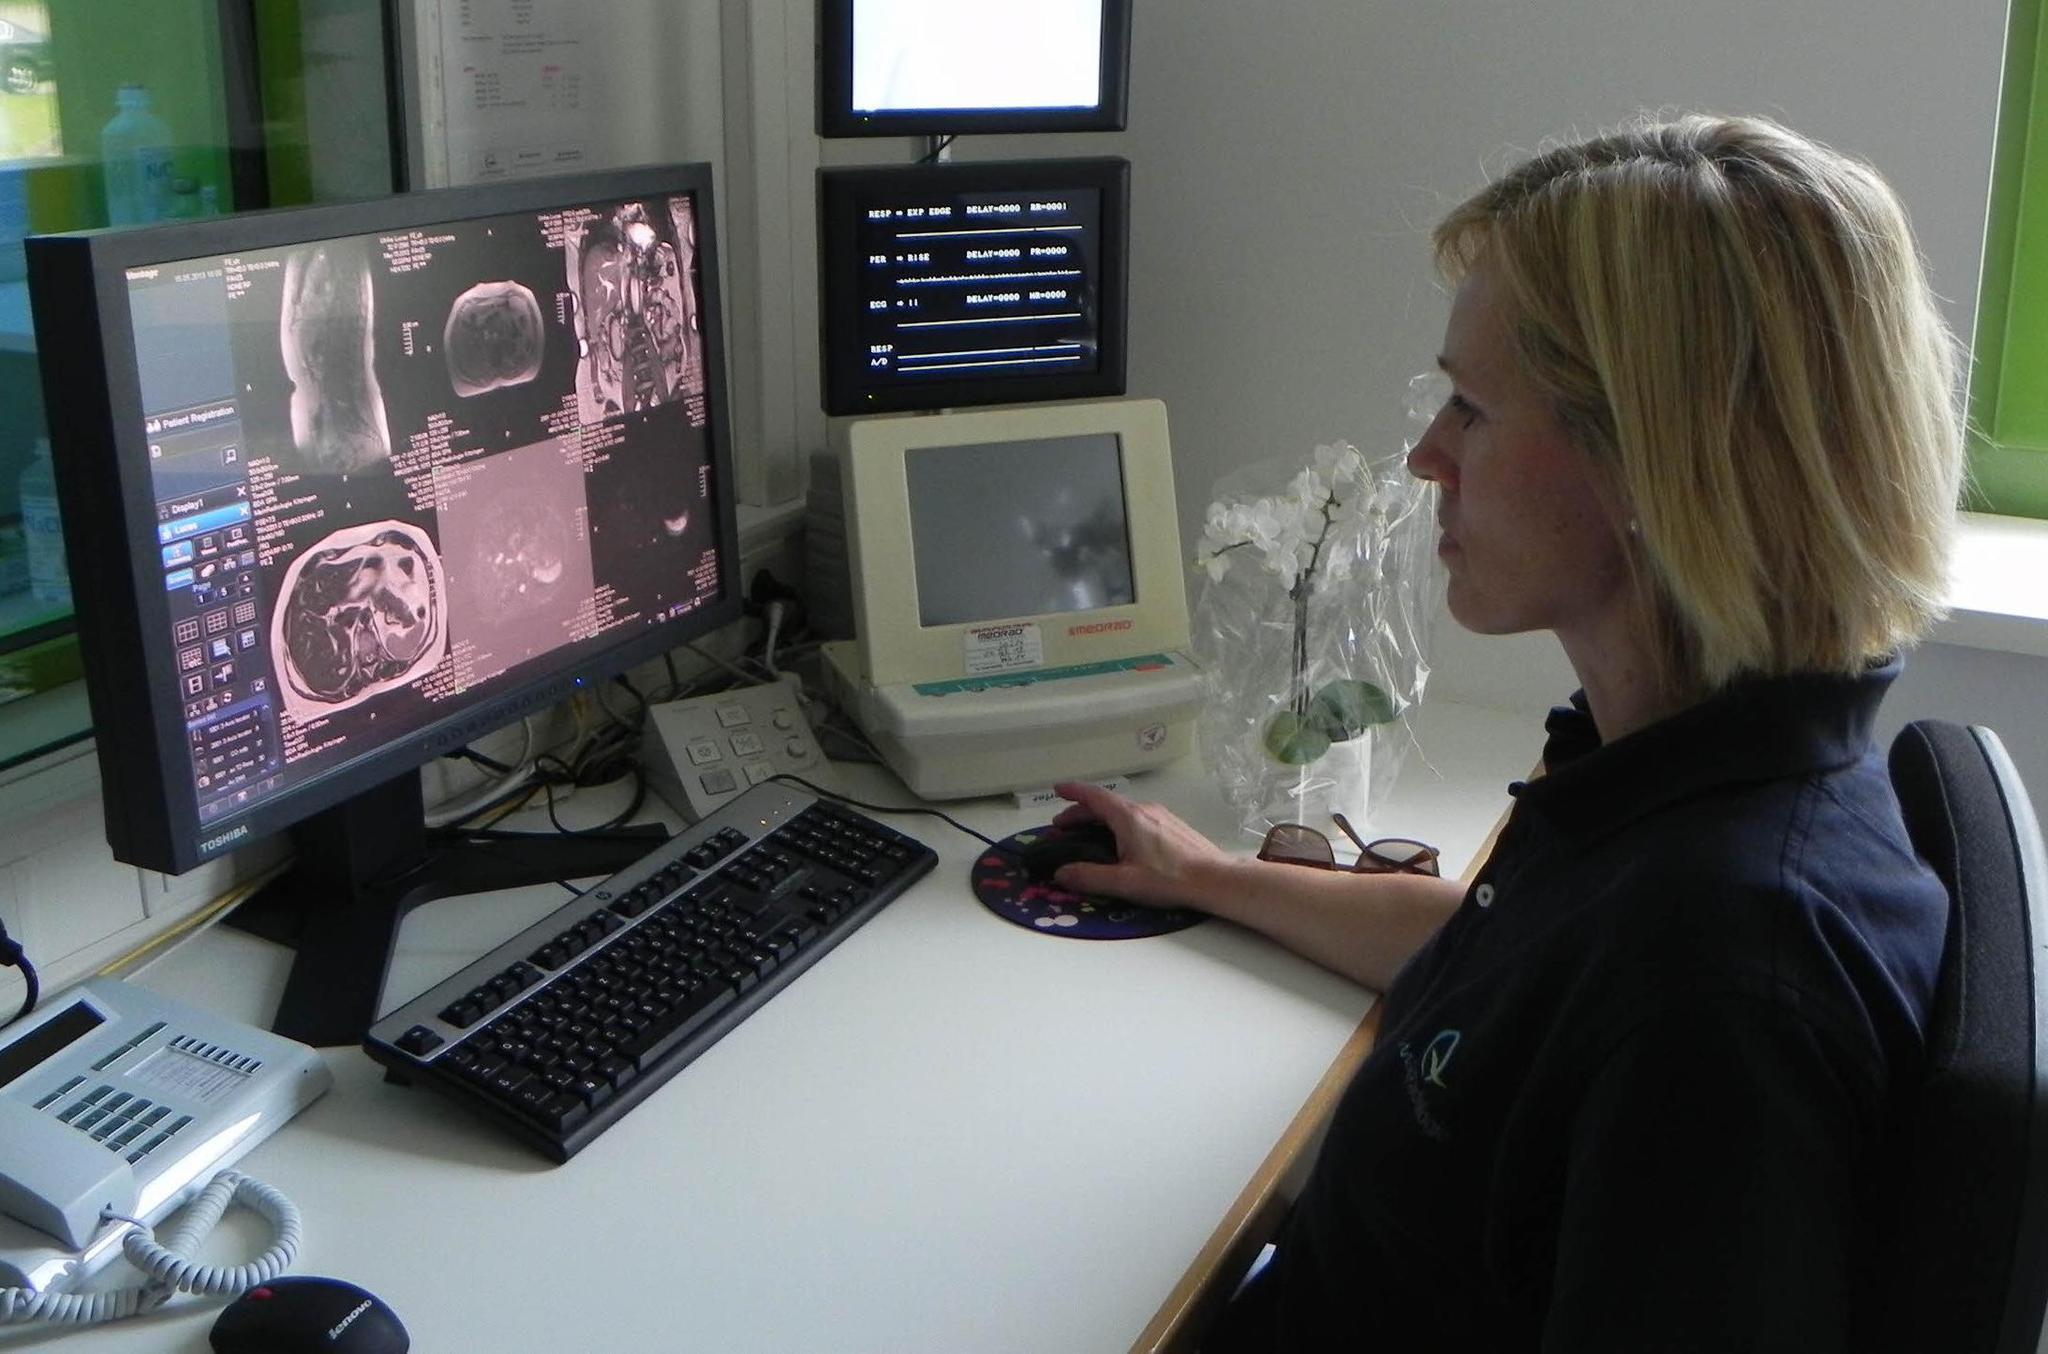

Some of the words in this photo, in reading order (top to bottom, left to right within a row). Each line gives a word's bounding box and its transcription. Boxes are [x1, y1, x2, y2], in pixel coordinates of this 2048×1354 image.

[868, 209, 892, 219] RESP
[907, 208, 924, 217] EXP
[928, 206, 952, 216] EDGE
[966, 204, 1020, 214] DELAY=0000
[869, 255, 887, 264] PER
[907, 252, 930, 262] RISE
[966, 248, 1020, 259] DELAY=0000
[1030, 246, 1067, 256] PR=0000
[870, 300, 887, 310] ECG
[966, 292, 1020, 303] DELAY=0000
[870, 344, 893, 353] RESP
[870, 357, 888, 366] A/D
[162, 415, 189, 428] Patient
[190, 407, 235, 423] Registration
[171, 498, 204, 515] Display1
[200, 826, 248, 851] TOSHIBA
[328, 1299, 373, 1340] lenovo
